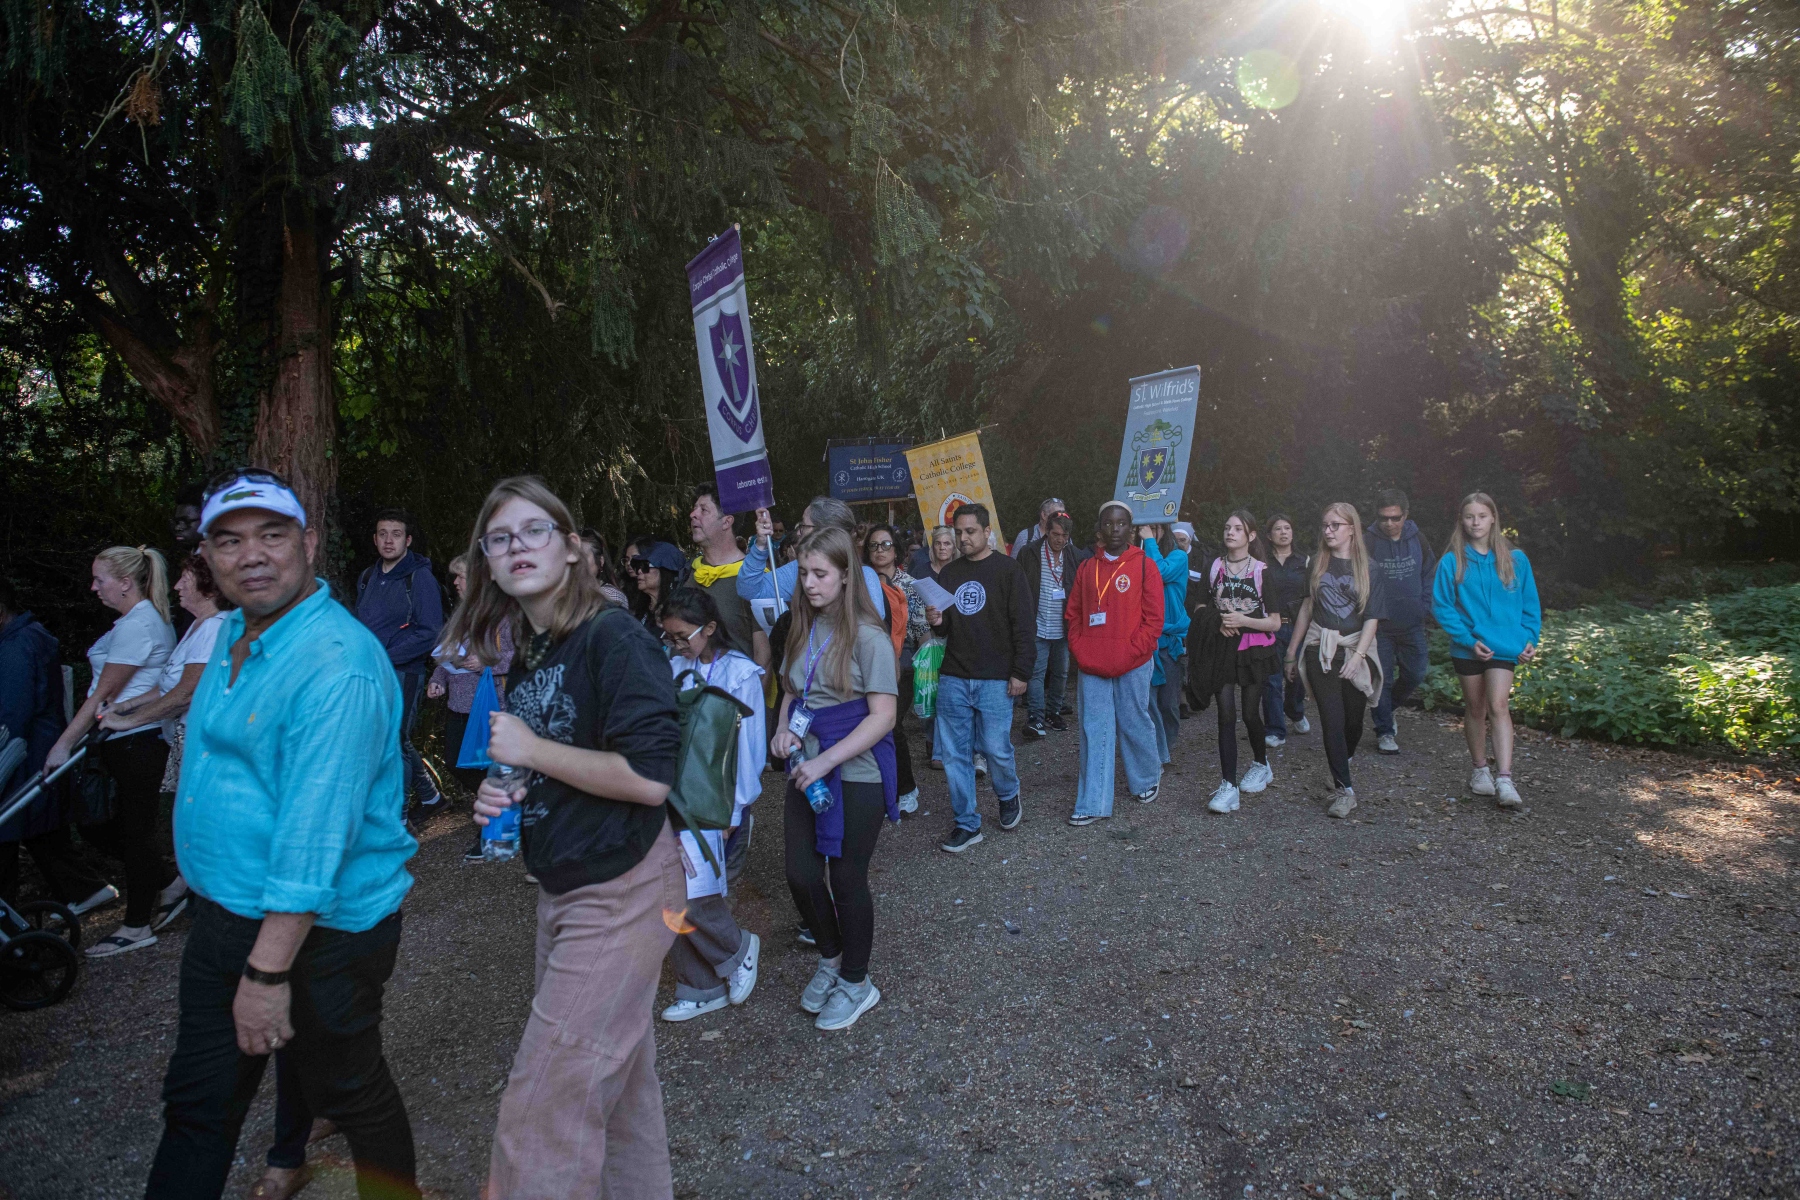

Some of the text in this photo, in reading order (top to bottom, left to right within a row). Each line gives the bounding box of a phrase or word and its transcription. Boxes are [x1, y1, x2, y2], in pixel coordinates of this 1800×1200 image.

[1150, 378, 1195, 400] Wilfrid's
[721, 405, 742, 436] CORPUS
[858, 457, 872, 466] John
[919, 468, 950, 481] Catholic
[950, 461, 976, 473] College
[930, 454, 962, 468] All Saints
